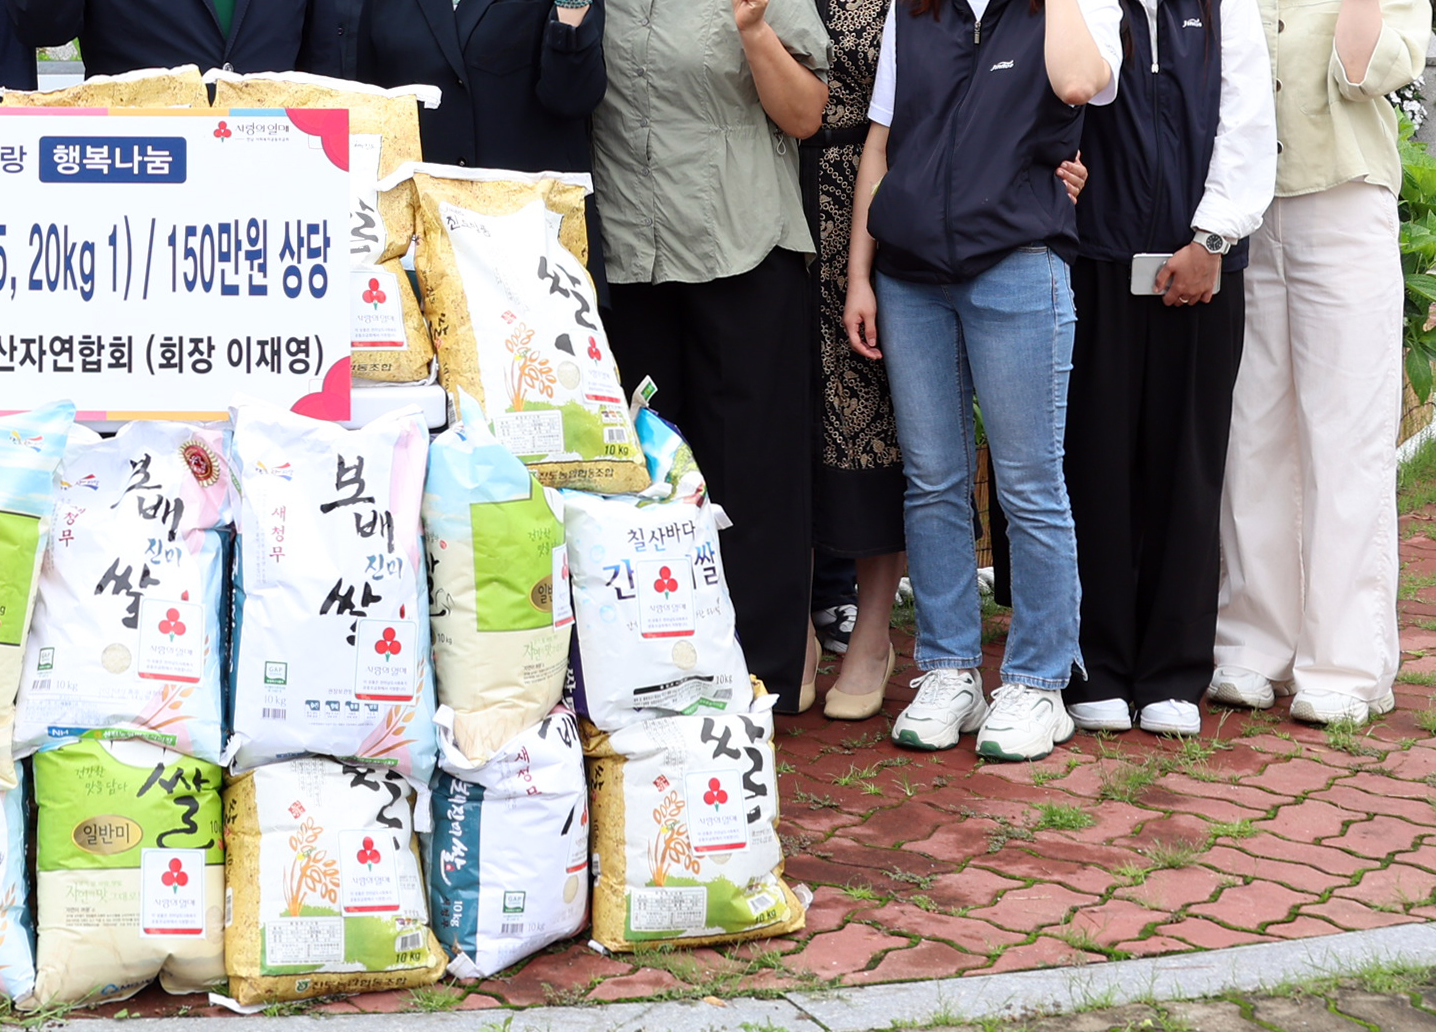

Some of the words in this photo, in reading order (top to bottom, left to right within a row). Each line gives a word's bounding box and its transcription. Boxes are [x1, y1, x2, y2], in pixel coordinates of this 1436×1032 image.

[52, 143, 173, 176] 행복나눔
[28, 223, 95, 301] 20kg
[108, 215, 132, 301] 1)
[142, 217, 155, 300] /
[167, 217, 268, 297] 150만원
[279, 218, 330, 298] 상당
[145, 332, 215, 375] (회장
[227, 333, 323, 375] 이재영)
[604, 445, 615, 455] 10
[269, 506, 286, 563] 새청무
[627, 520, 696, 552] 칠산바다
[144, 538, 182, 567] 진미
[365, 554, 403, 580] 진미
[94, 557, 161, 629] 쌀
[437, 633, 445, 643] 10
[446, 637, 452, 645] kg
[75, 765, 105, 778] 건강한
[85, 780, 102, 795] 맛을
[106, 779, 127, 795] 담다
[136, 762, 214, 848] 쌀
[83, 823, 130, 845] 일반미
[755, 913, 765, 923] 10
[395, 953, 407, 963] 10
[410, 952, 421, 962] kg
